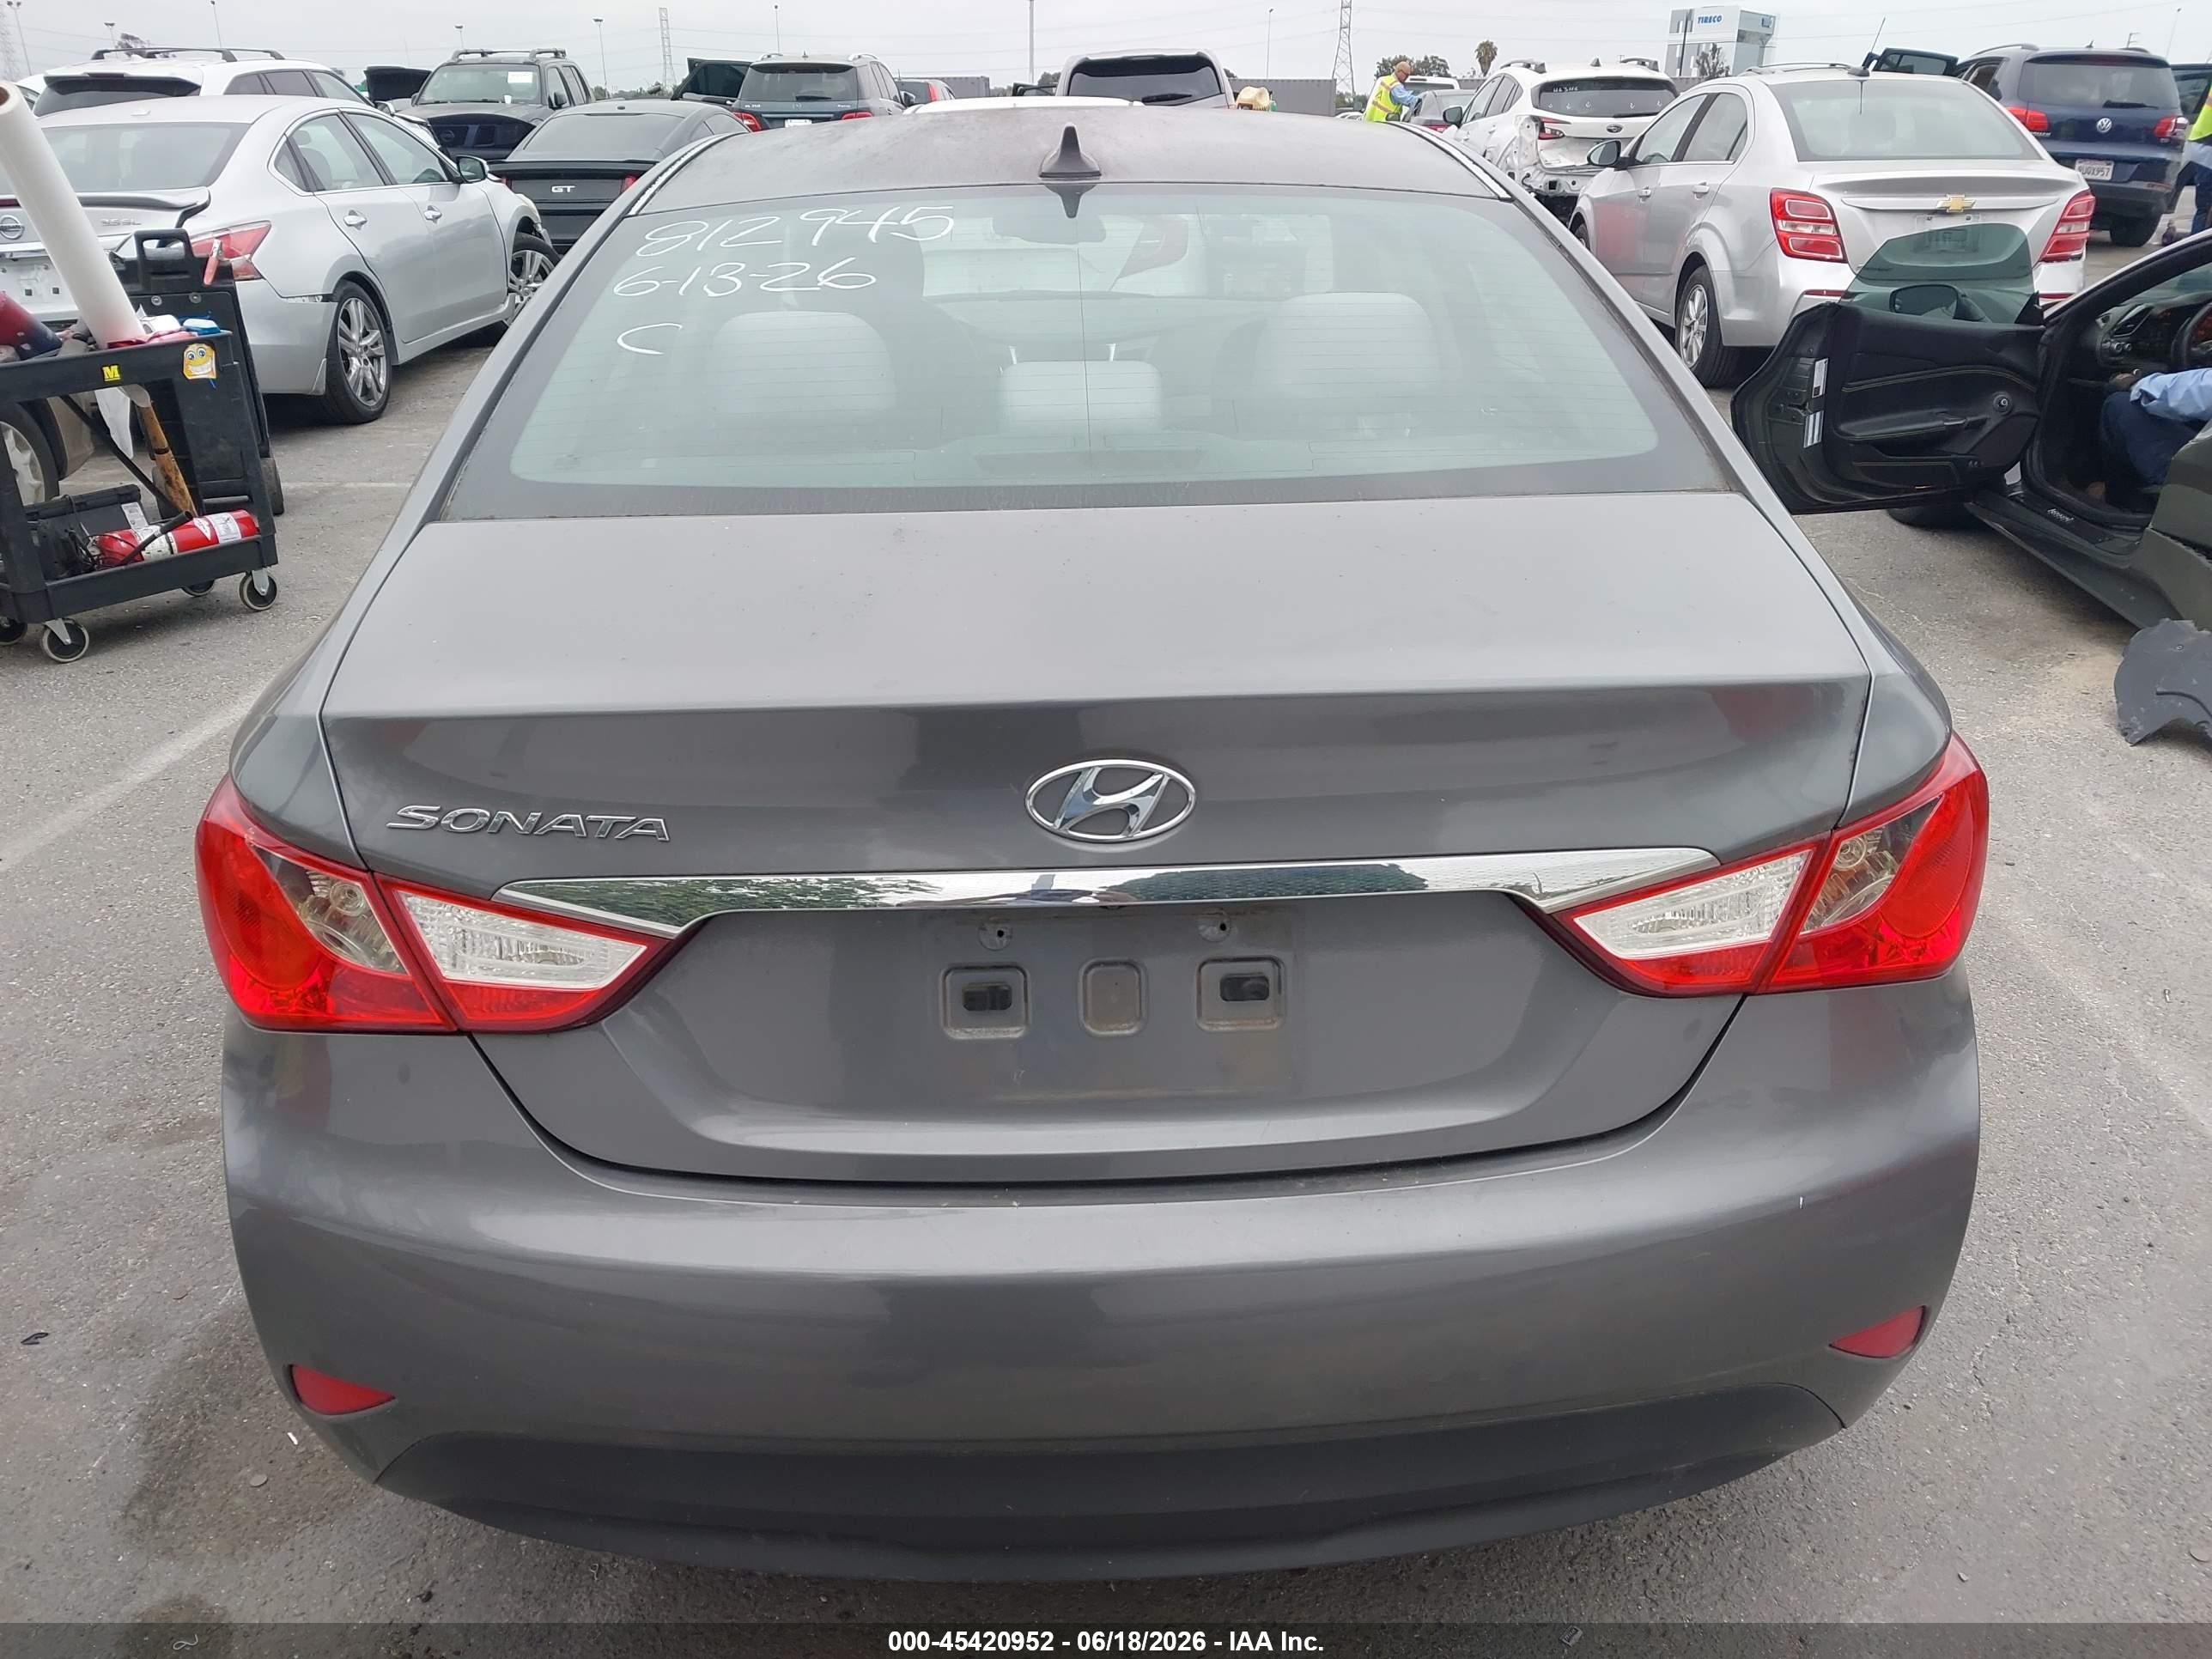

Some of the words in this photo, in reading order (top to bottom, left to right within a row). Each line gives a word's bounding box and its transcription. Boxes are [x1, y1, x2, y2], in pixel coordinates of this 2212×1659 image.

[1697, 15, 1723, 24] TIRECO
[635, 216, 784, 258] 812
[799, 206, 954, 246] 945
[612, 258, 878, 297] 6-13-26
[102, 365, 120, 381] M
[386, 805, 671, 842] SONATA
